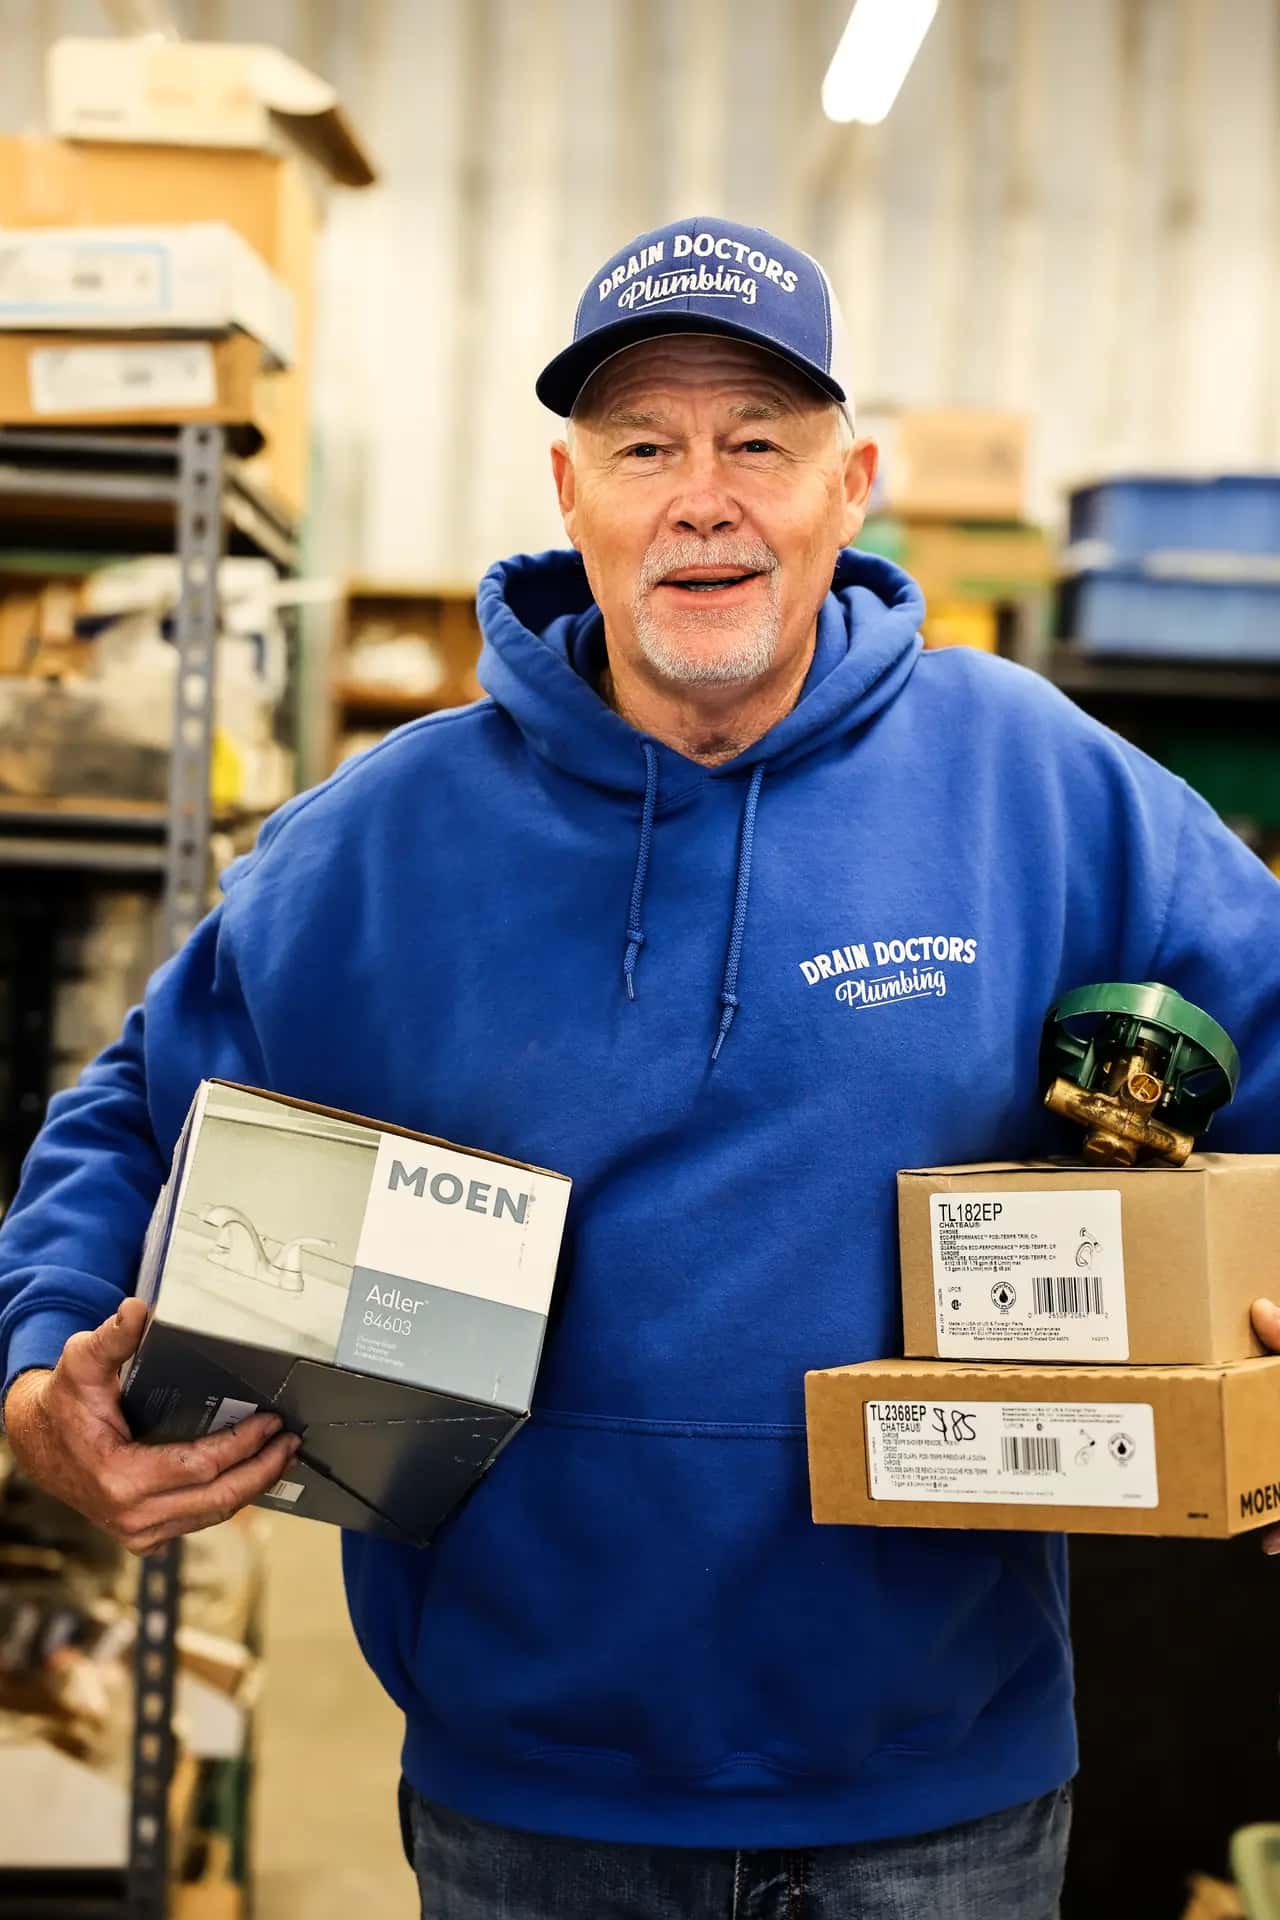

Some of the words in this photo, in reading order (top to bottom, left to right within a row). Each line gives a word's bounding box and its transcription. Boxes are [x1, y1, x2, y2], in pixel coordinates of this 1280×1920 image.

[599, 241, 664, 301] DRAIN
[673, 234, 799, 293] DOCTORS
[618, 264, 759, 309] Plumbing
[799, 944, 870, 985] DRAIN
[872, 936, 977, 964] DOCTORS
[835, 967, 947, 1006] Plumbing
[388, 1160, 529, 1225] MOEN
[938, 1203, 1003, 1221] TL182EP
[363, 1310, 412, 1336] 84603
[870, 1405, 926, 1421] TL2368EP
[1240, 1482, 1280, 1518] MOEN
